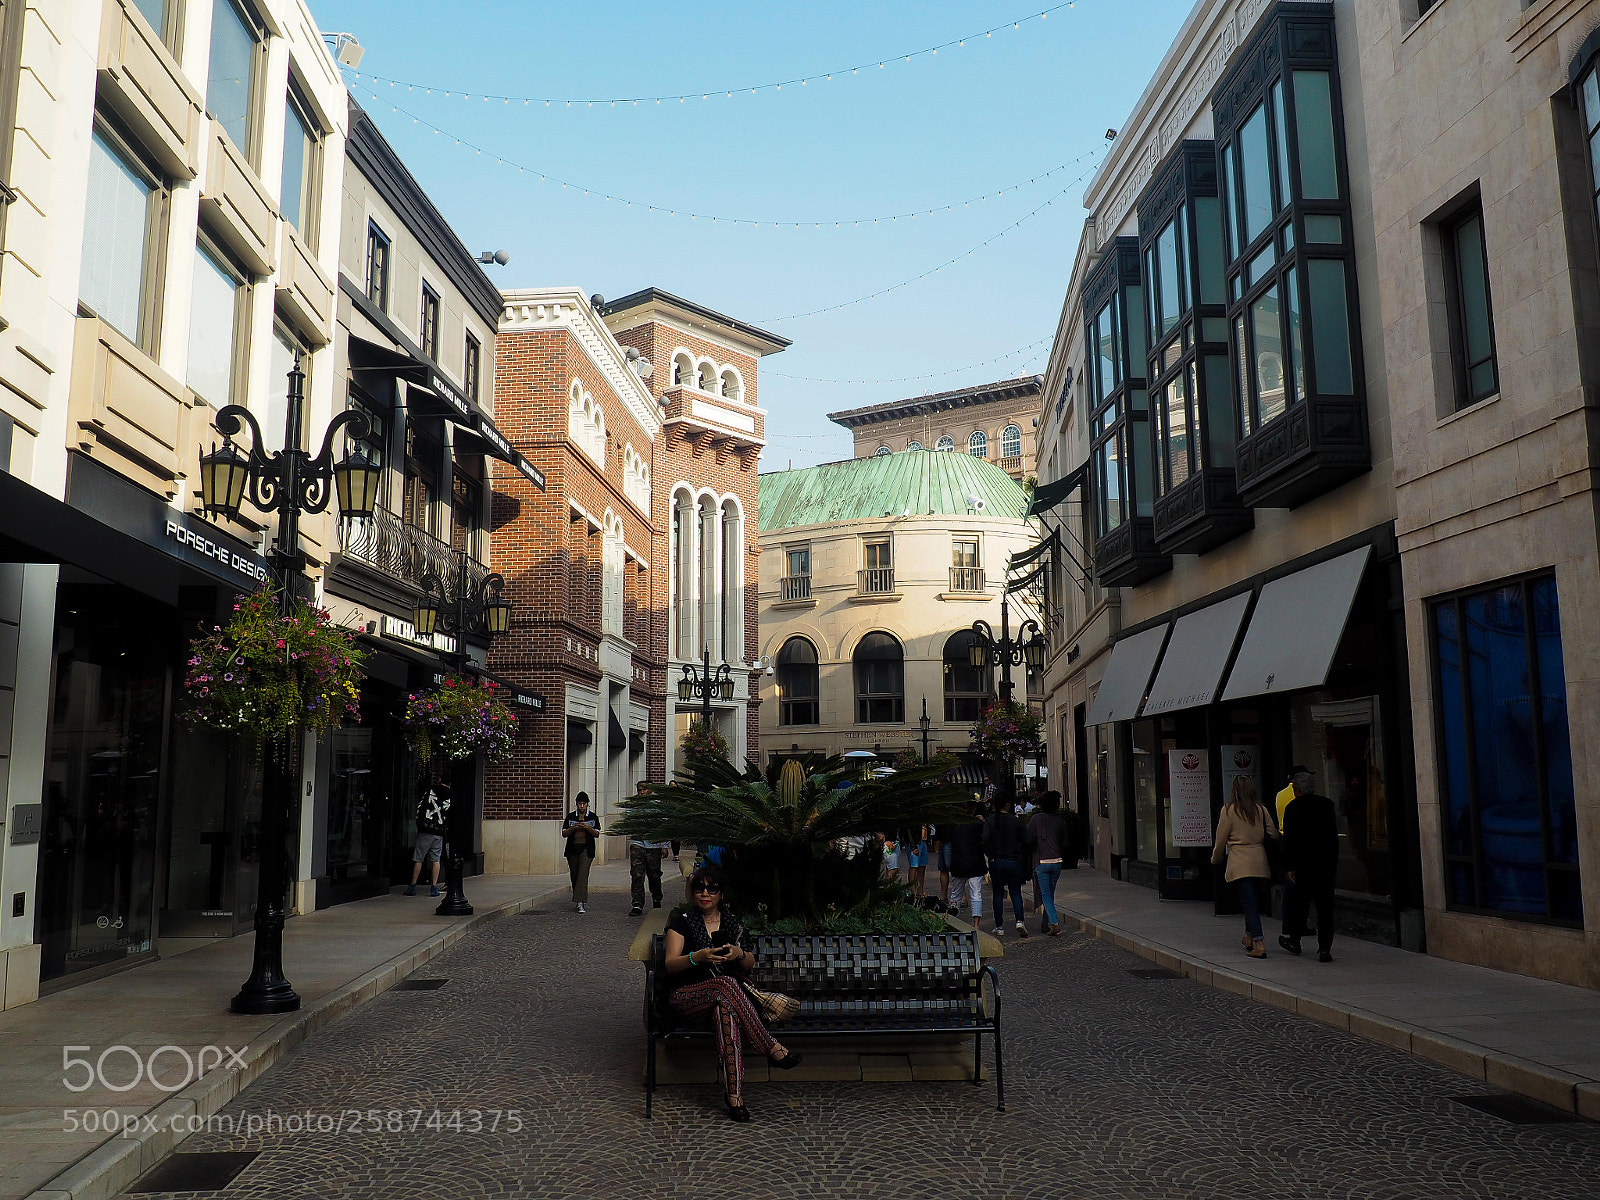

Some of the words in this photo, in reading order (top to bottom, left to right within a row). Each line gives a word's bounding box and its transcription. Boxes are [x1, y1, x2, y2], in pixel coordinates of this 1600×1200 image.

[433, 376, 454, 402] RICHARD
[454, 395, 468, 415] MILLE
[481, 421, 499, 442] RICHARD
[498, 437, 510, 454] MILLE
[166, 520, 230, 565] PORSCHE
[231, 553, 271, 583] DESIGN
[433, 631, 457, 653] MILL
[1177, 691, 1210, 705] MICHAEL
[844, 731, 877, 739] STEPHEN
[878, 730, 914, 739] WEBSTER
